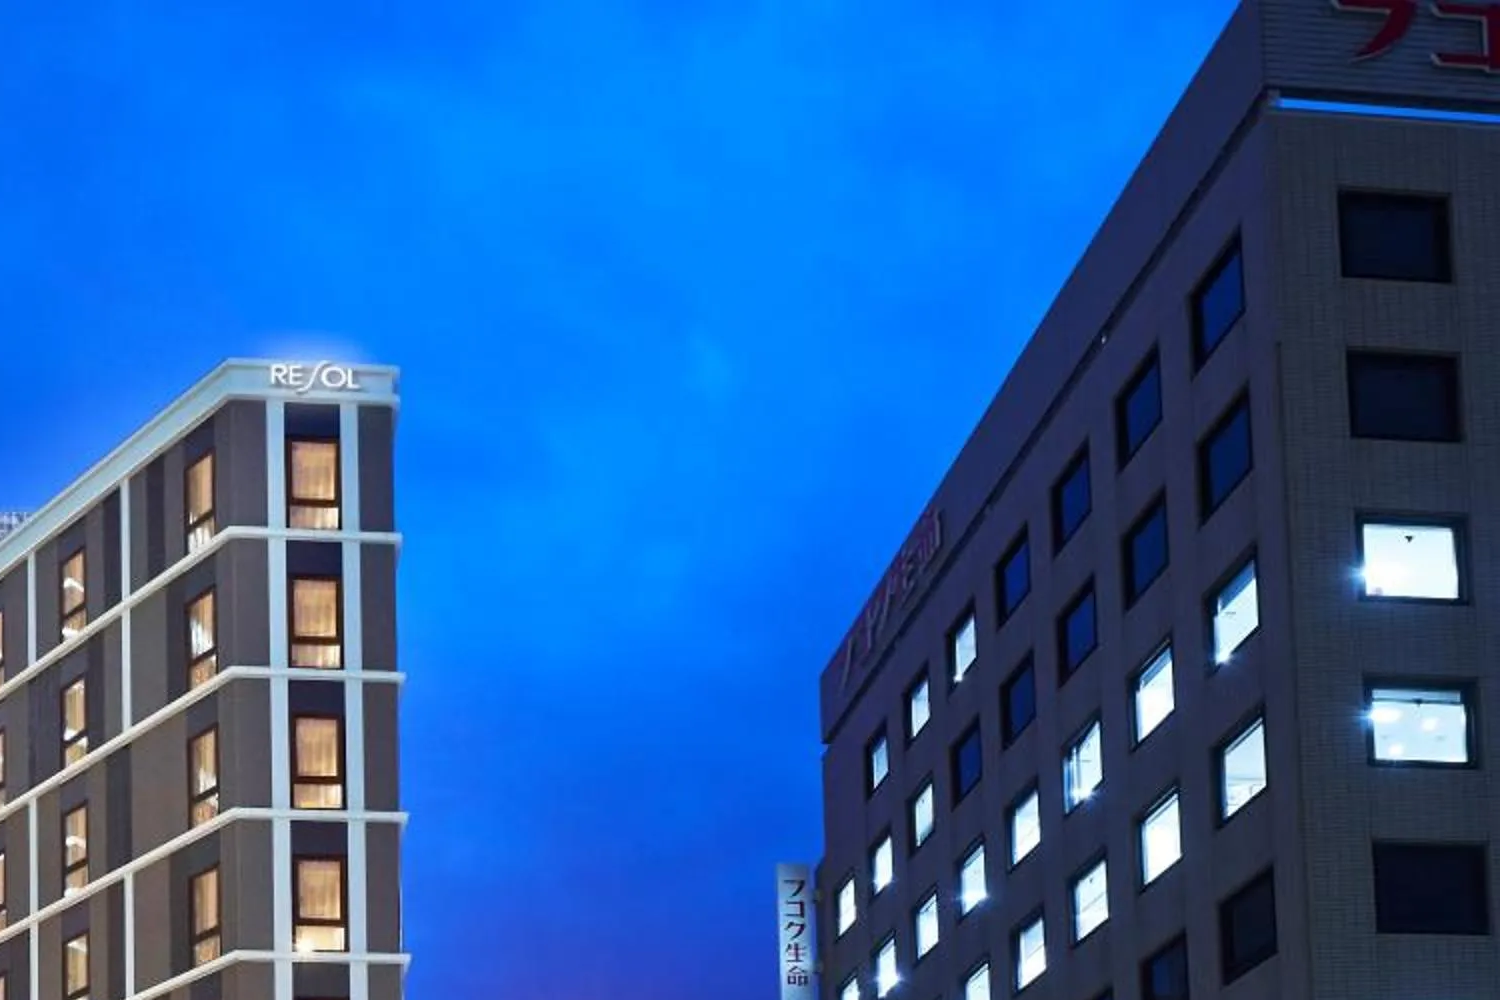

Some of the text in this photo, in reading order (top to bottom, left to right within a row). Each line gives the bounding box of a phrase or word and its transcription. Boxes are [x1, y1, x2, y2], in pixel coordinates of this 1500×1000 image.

[270, 360, 361, 393] RESOL
[783, 879, 808, 986] フコク生命
